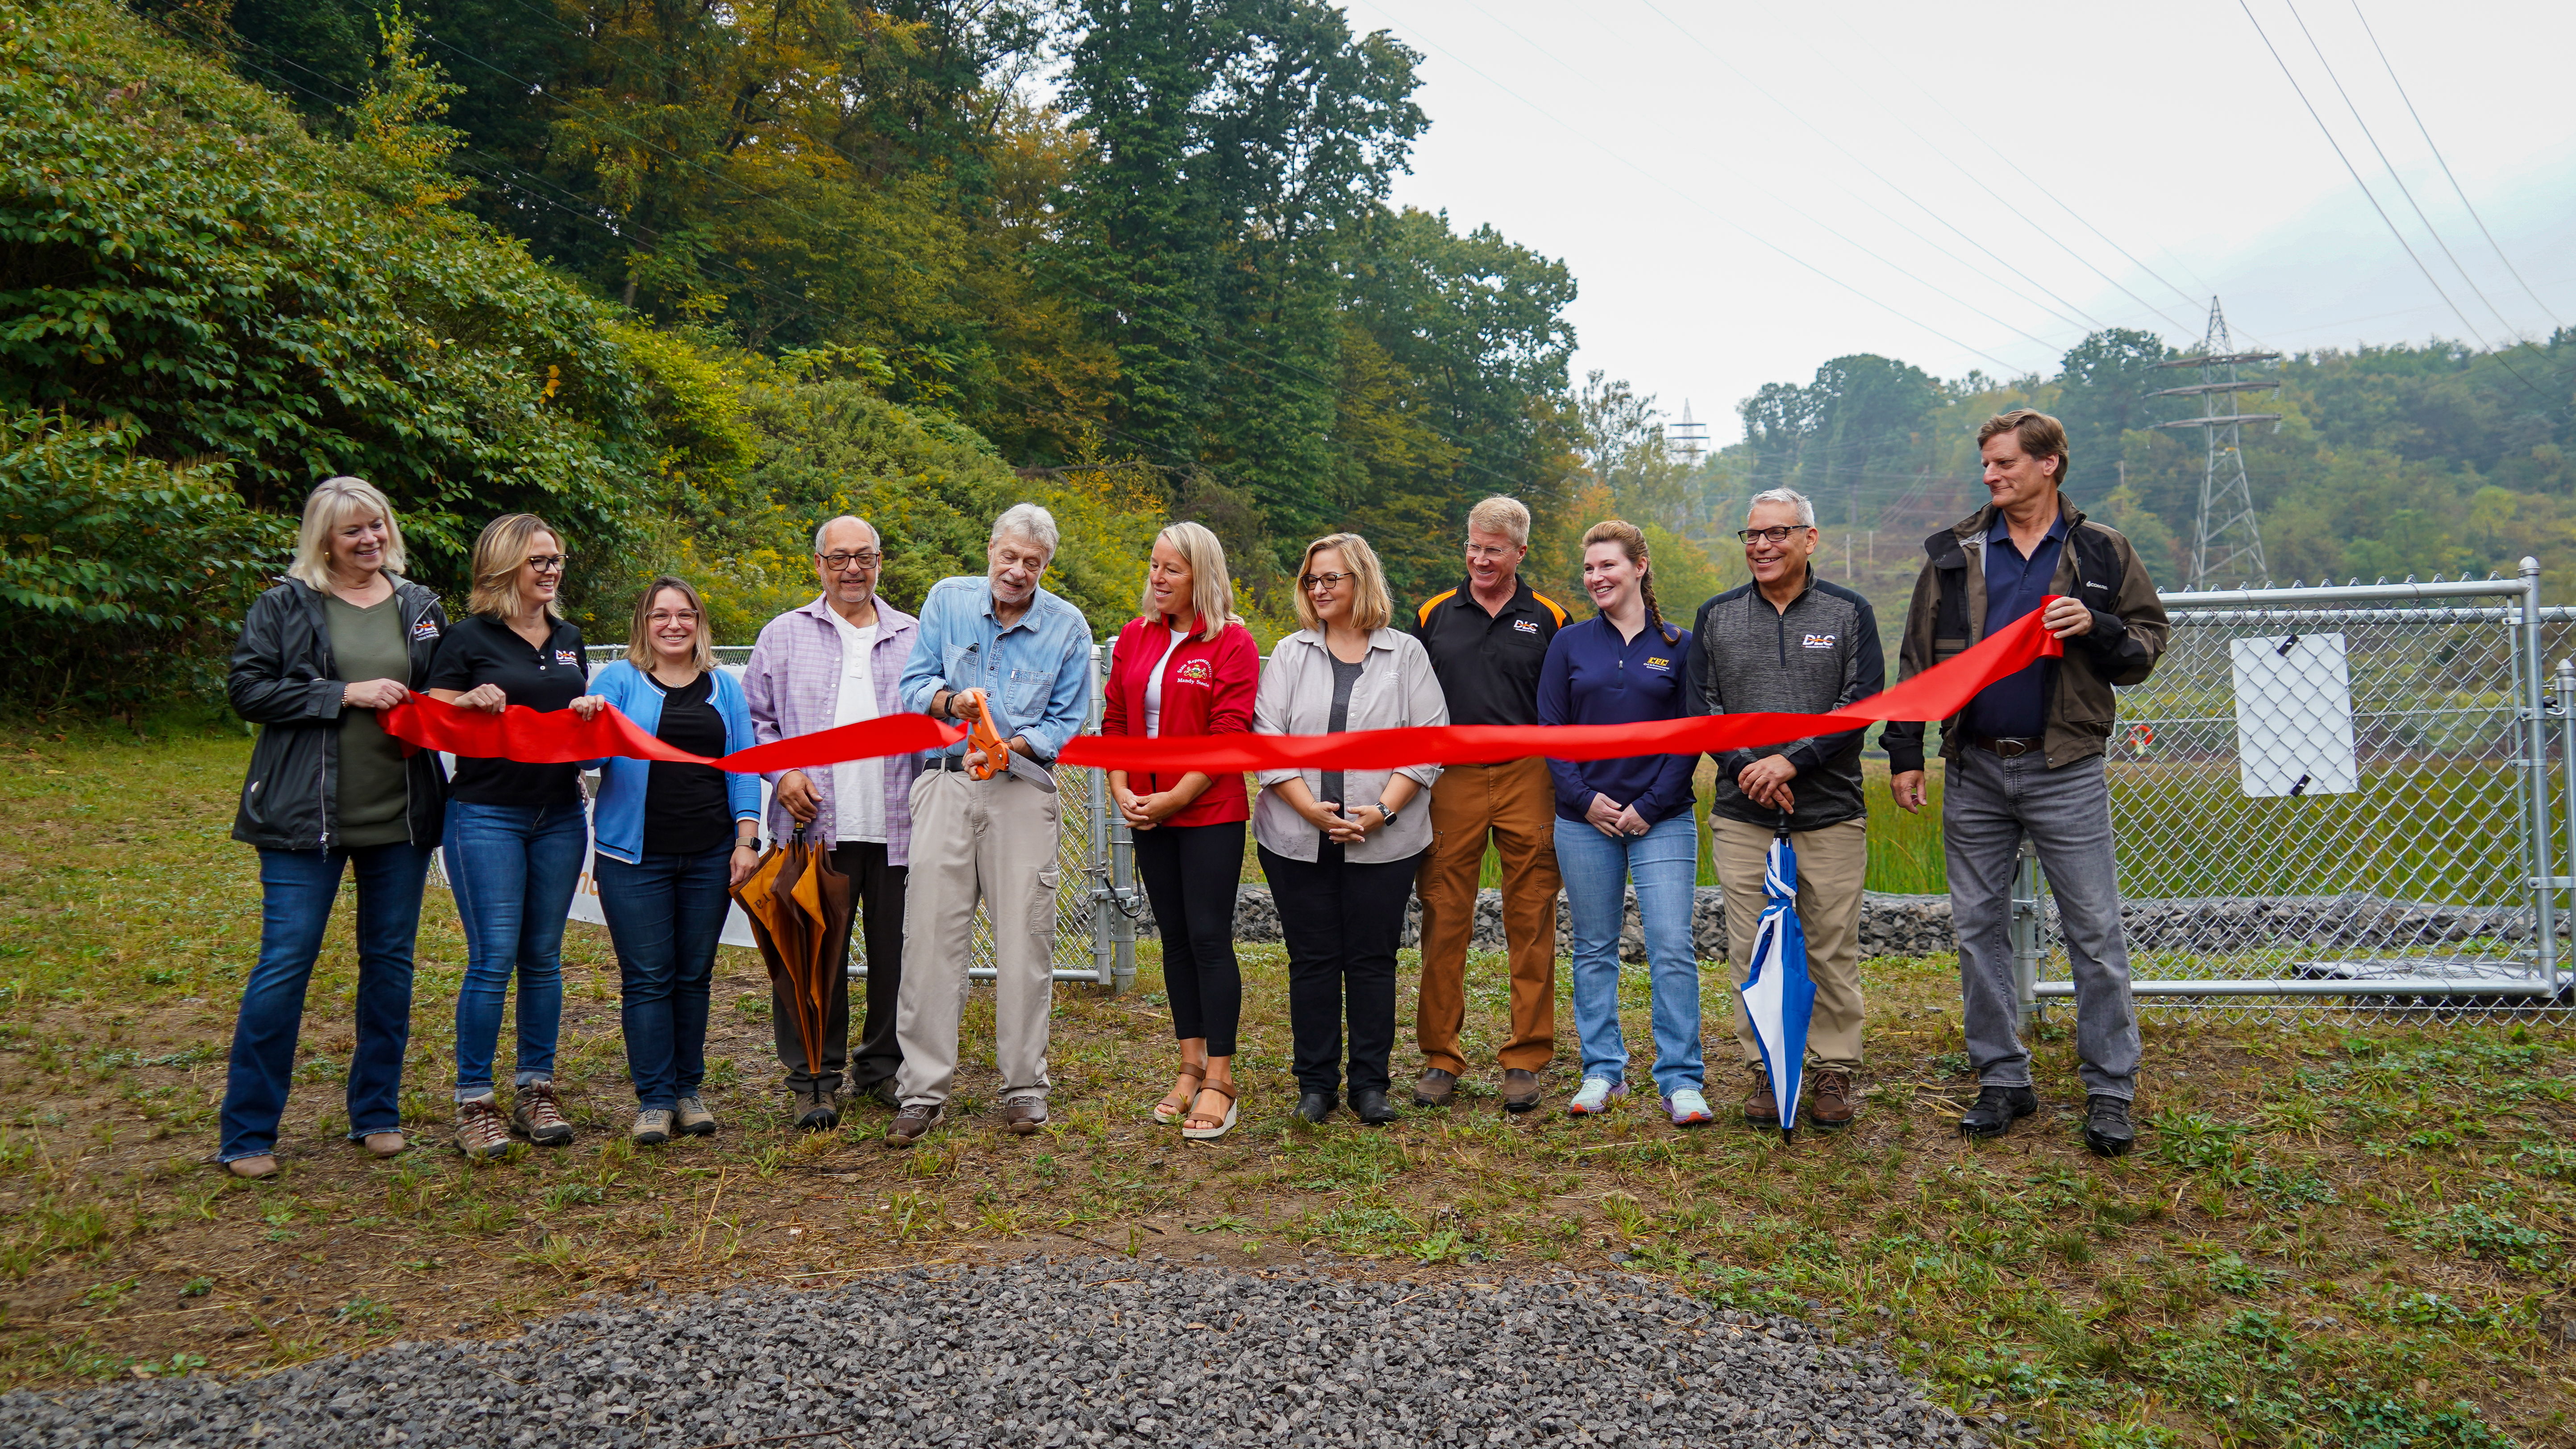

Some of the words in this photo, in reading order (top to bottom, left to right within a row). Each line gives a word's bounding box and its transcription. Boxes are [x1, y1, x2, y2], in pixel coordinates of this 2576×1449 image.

[413, 620, 437, 635] DLC
[1513, 619, 1539, 631] DLC
[1802, 634, 1836, 646] DLC
[555, 650, 577, 661] DLC
[1648, 657, 1669, 666] CEC
[1177, 664, 1187, 673] State
[1196, 679, 1210, 688] Steele
[753, 888, 771, 909] ra
